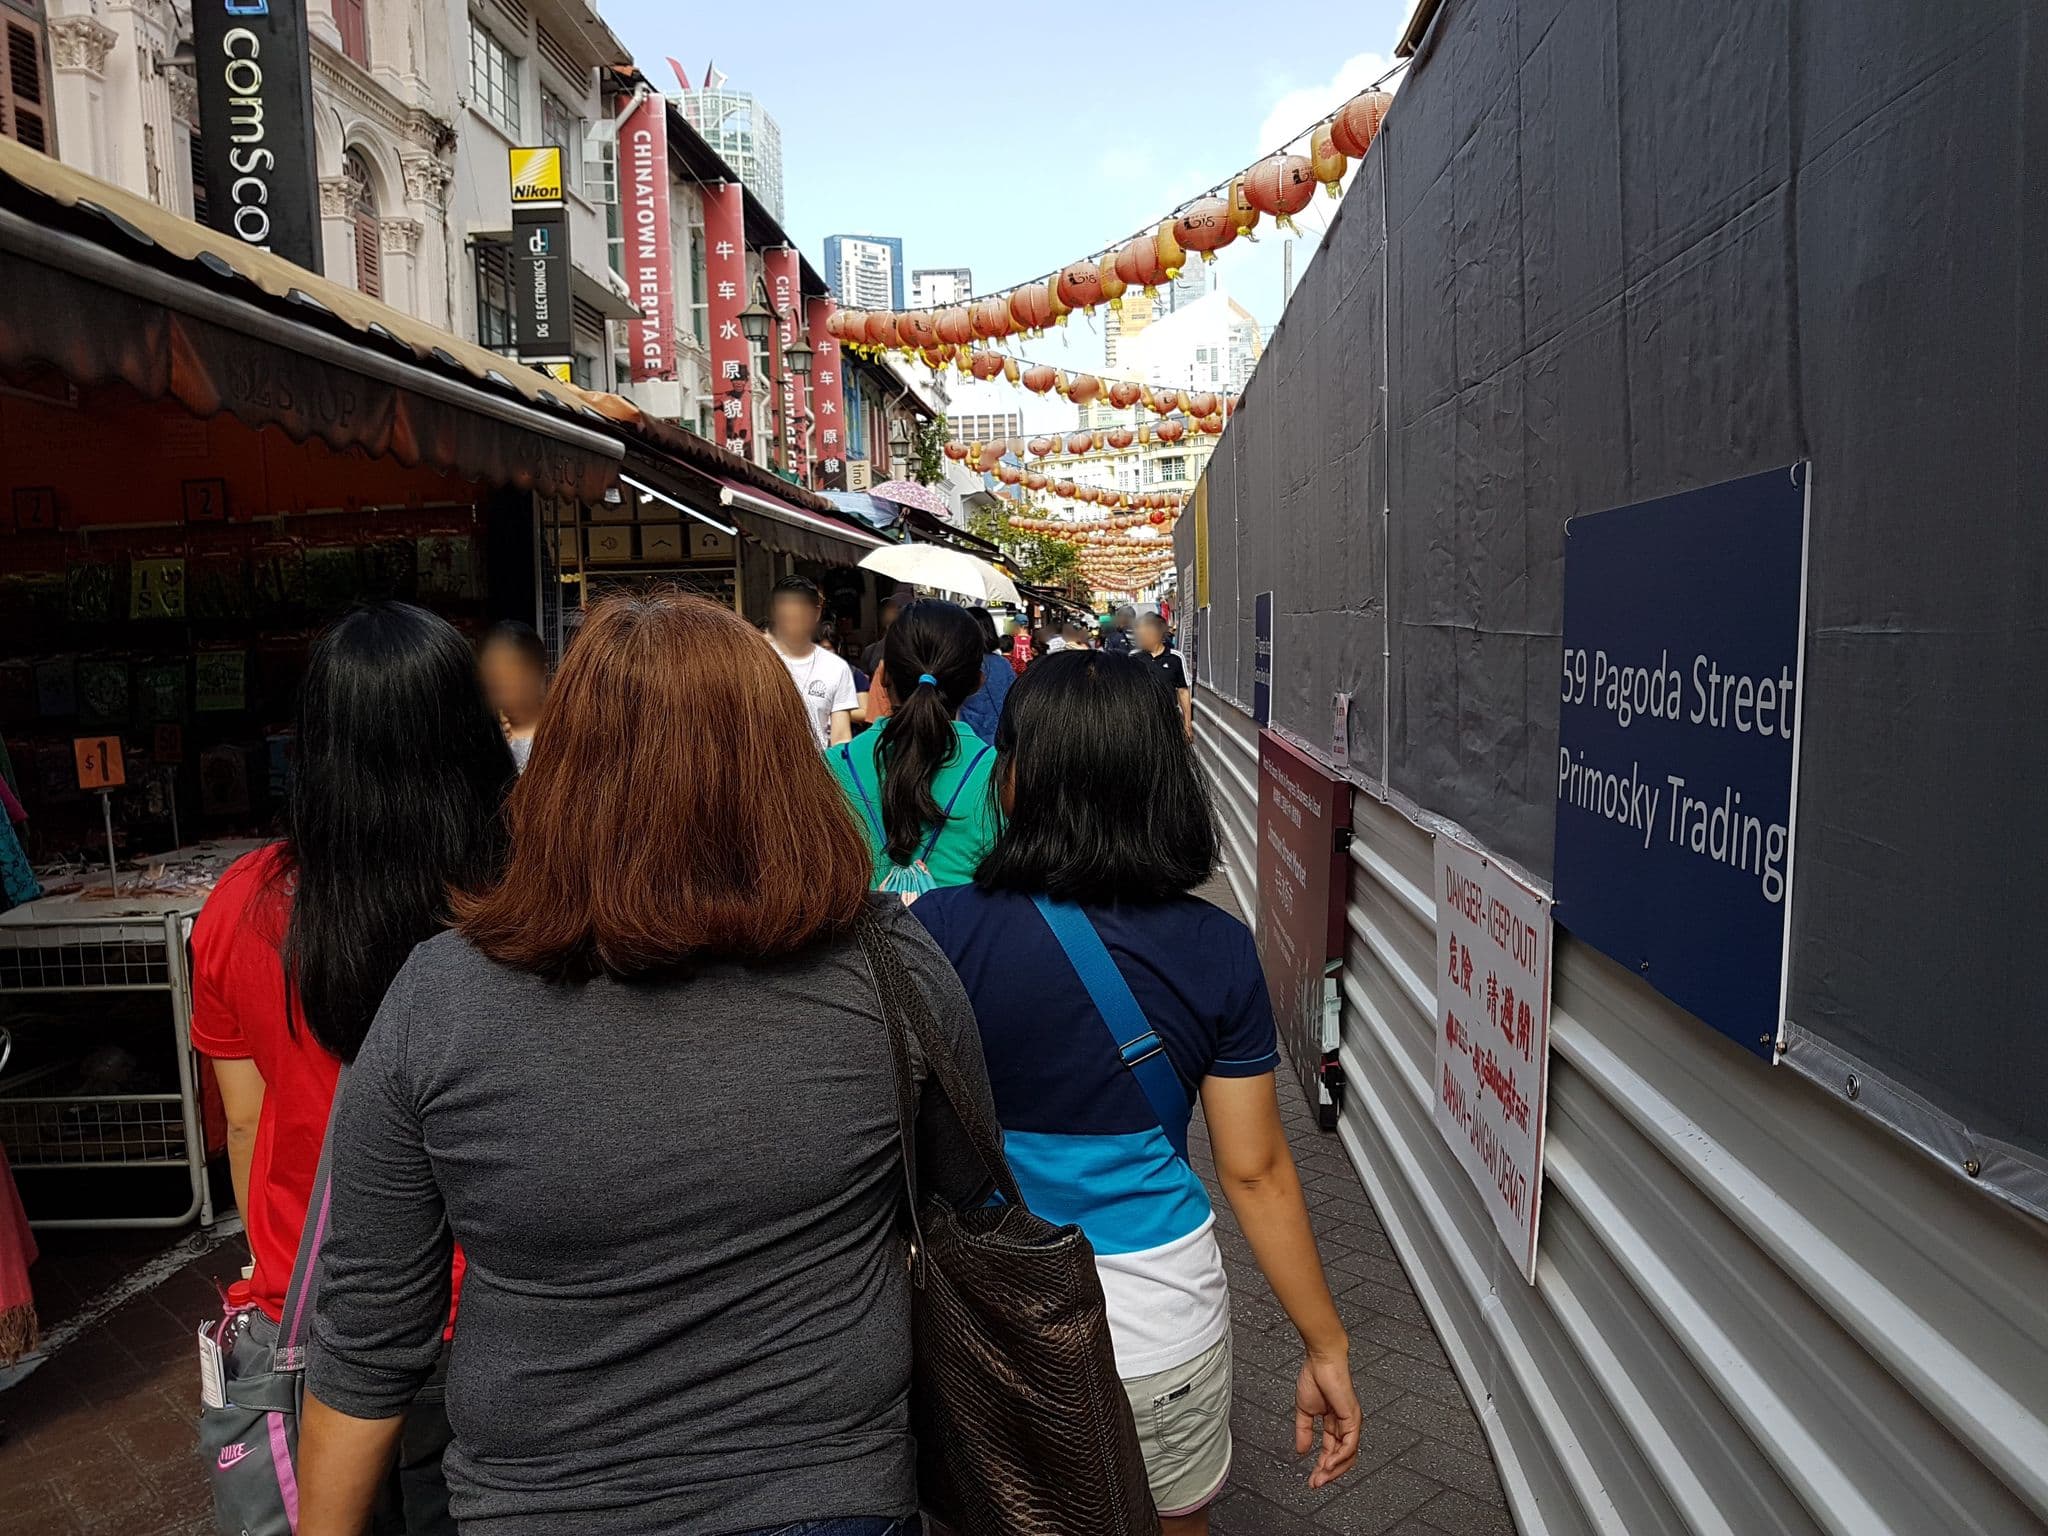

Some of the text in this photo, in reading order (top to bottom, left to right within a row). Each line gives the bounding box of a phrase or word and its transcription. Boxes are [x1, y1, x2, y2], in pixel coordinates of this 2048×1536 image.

[223, 28, 275, 253] comSco
[514, 185, 559, 199] Nikon
[633, 130, 656, 258] CHINATOWN
[534, 259, 549, 338] DG ELECTRONICS
[639, 267, 662, 369] HERITAGE
[1561, 649, 1793, 739] 59 Pagoda Street
[1558, 746, 1787, 903] Primosky Trading
[1446, 865, 1482, 928] DANGER
[1487, 895, 1511, 951] KEEP
[1512, 915, 1538, 977] OUT!
[1498, 1148, 1527, 1228] DEKAT!
